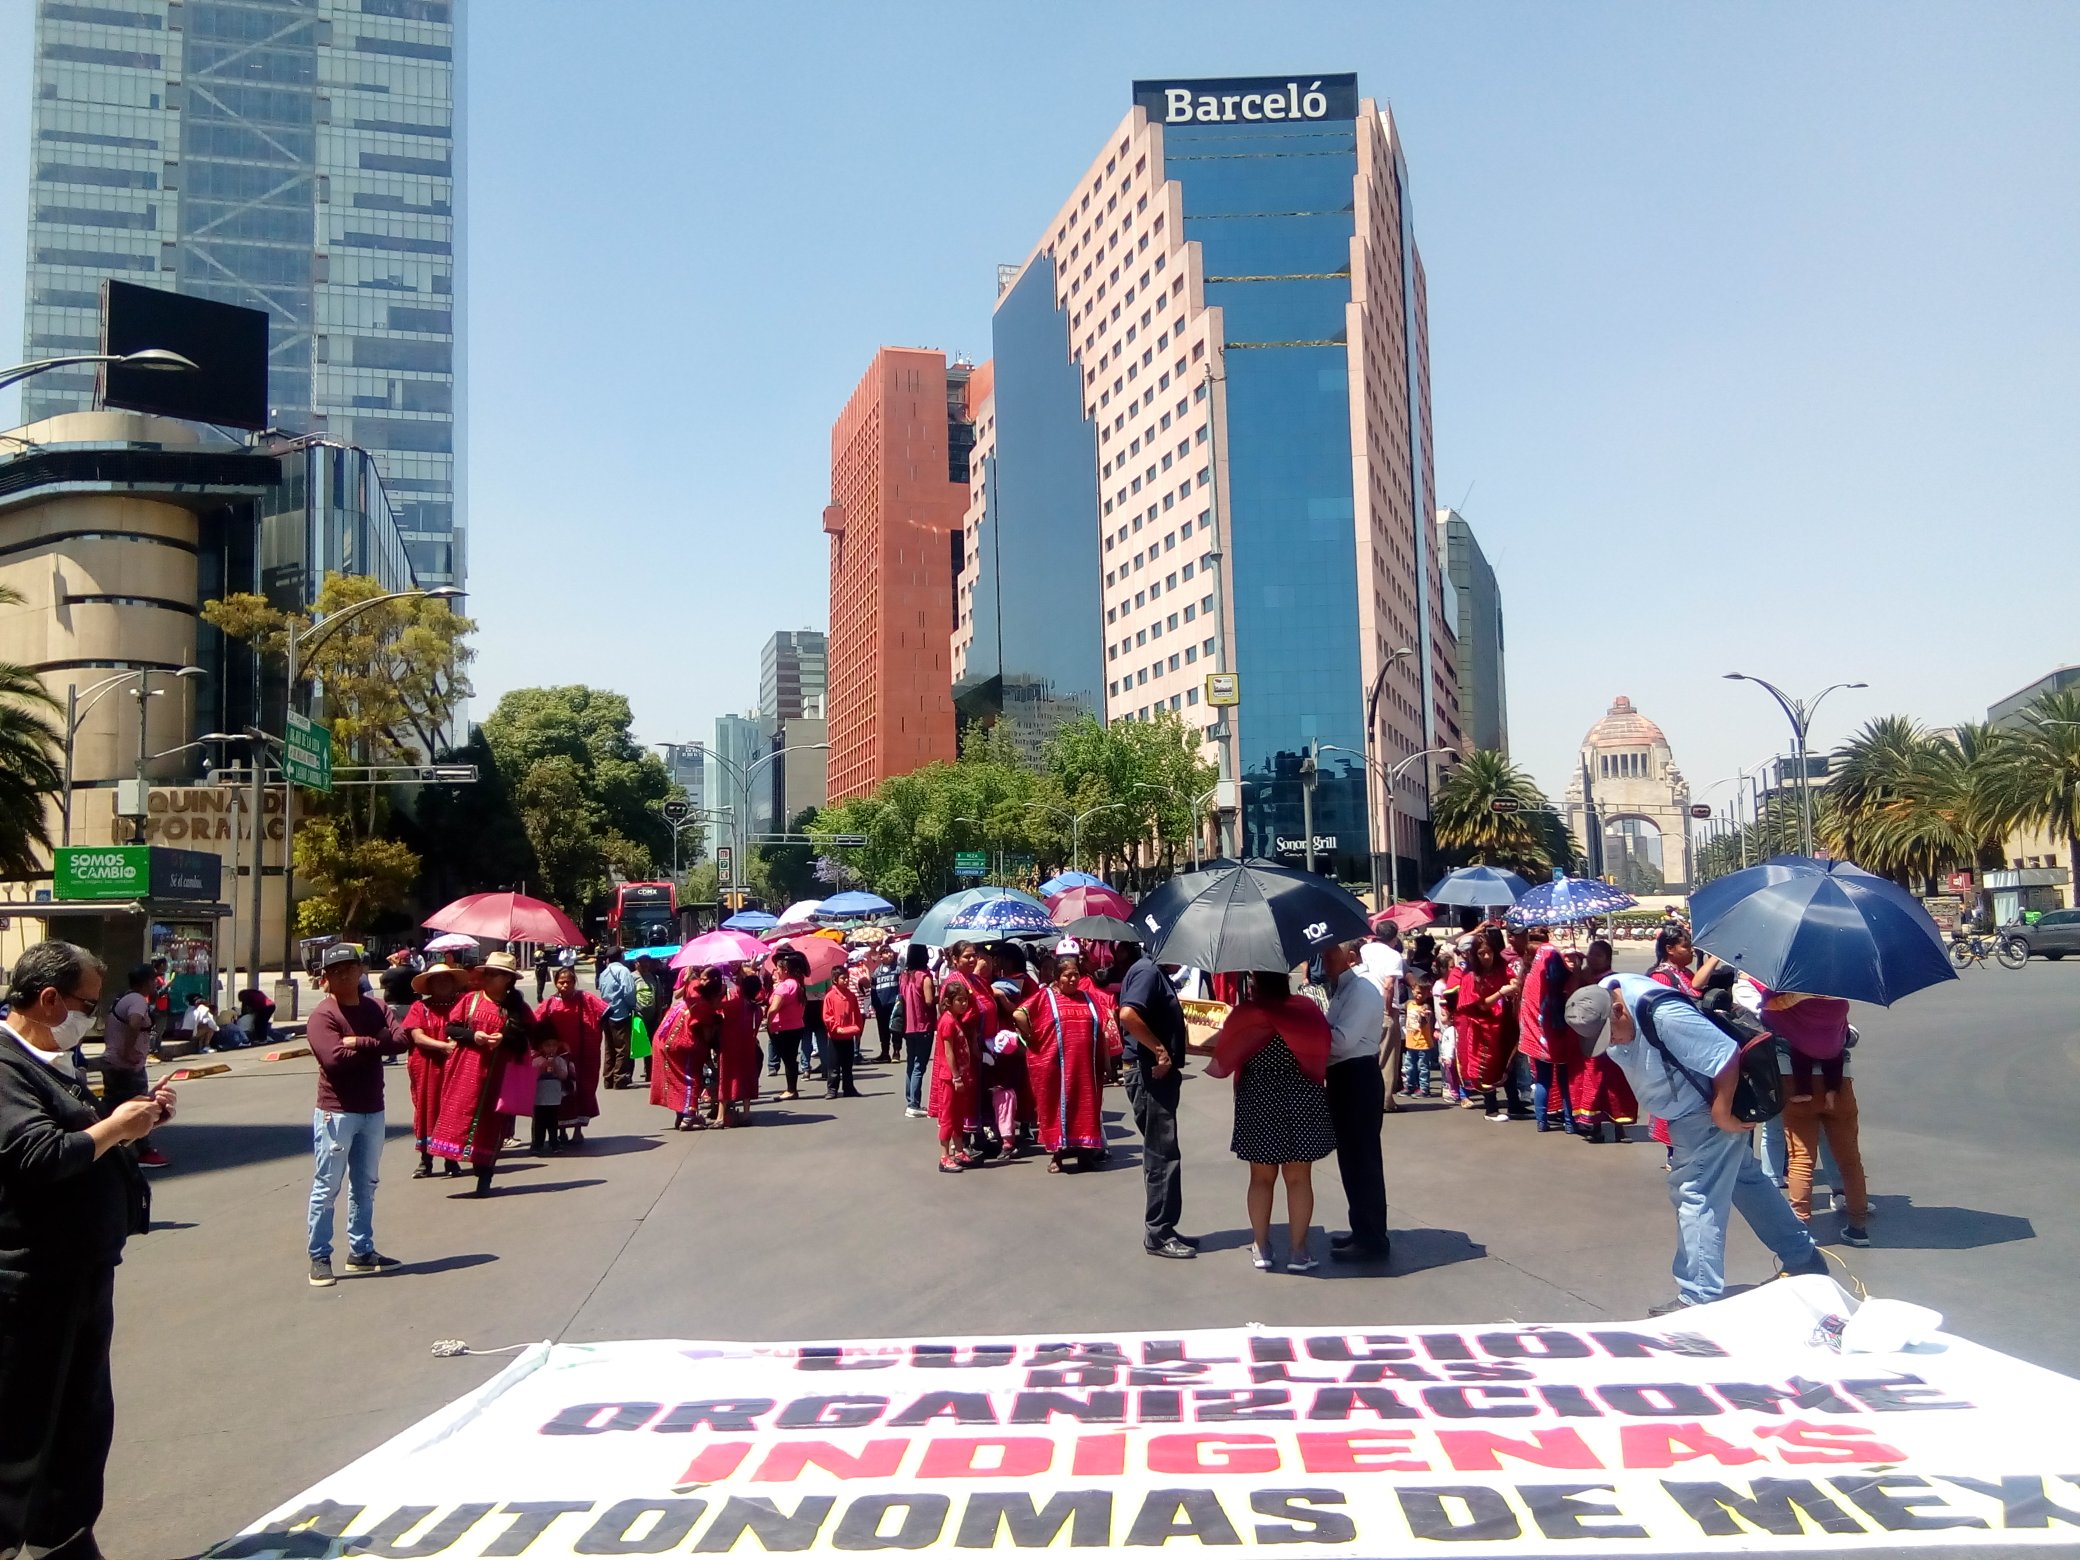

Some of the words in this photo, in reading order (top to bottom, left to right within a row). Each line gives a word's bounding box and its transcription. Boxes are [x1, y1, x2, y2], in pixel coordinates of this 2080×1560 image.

[1164, 81, 1327, 123] Barceló
[1276, 837, 1307, 851] Sonor
[1313, 836, 1337, 850] grill
[71, 854, 125, 867] SOMOS
[78, 867, 136, 879] CAMBIO
[1302, 921, 1328, 940] TOP
[1248, 1361, 1537, 1384] LAS
[1393, 1484, 1651, 1542] DE
